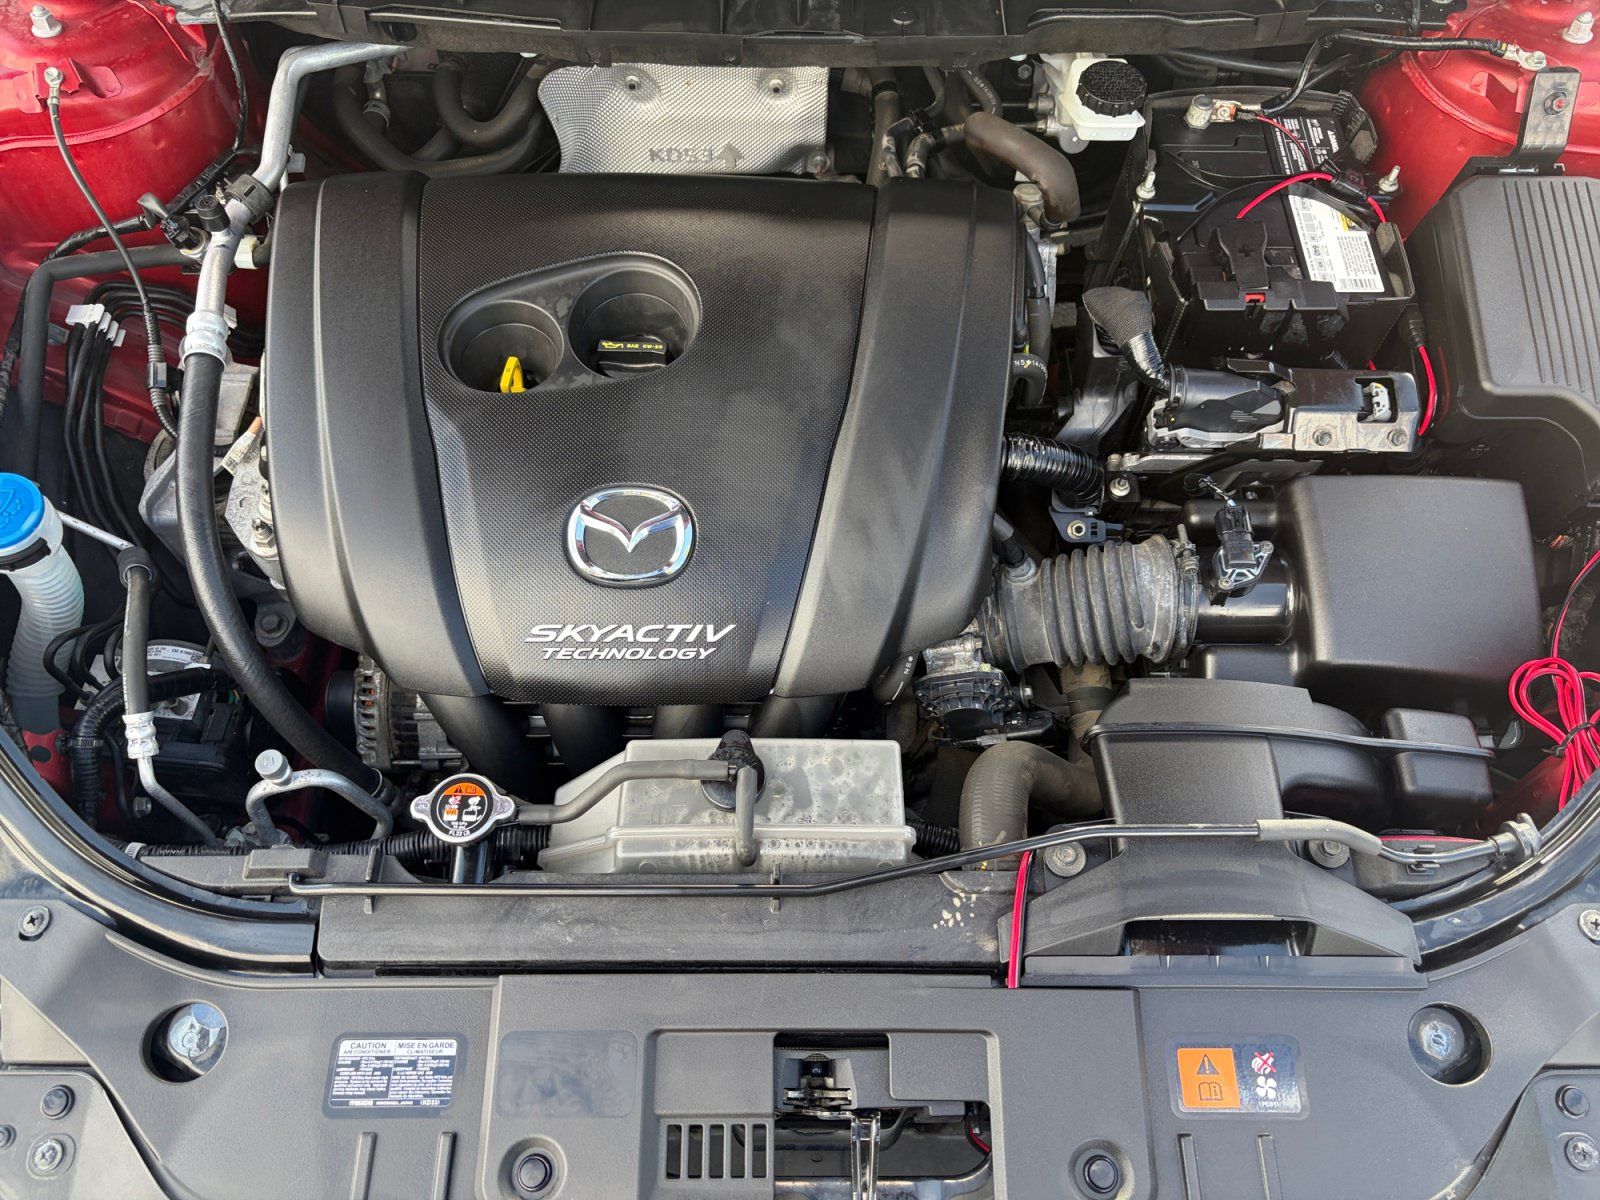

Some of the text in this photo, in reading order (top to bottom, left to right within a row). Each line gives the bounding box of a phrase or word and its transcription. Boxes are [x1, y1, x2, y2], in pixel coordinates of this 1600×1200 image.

[524, 623, 737, 643] SKYACTIV
[542, 647, 717, 661] TECHNOLOGY
[350, 1042, 387, 1050] CAUTION
